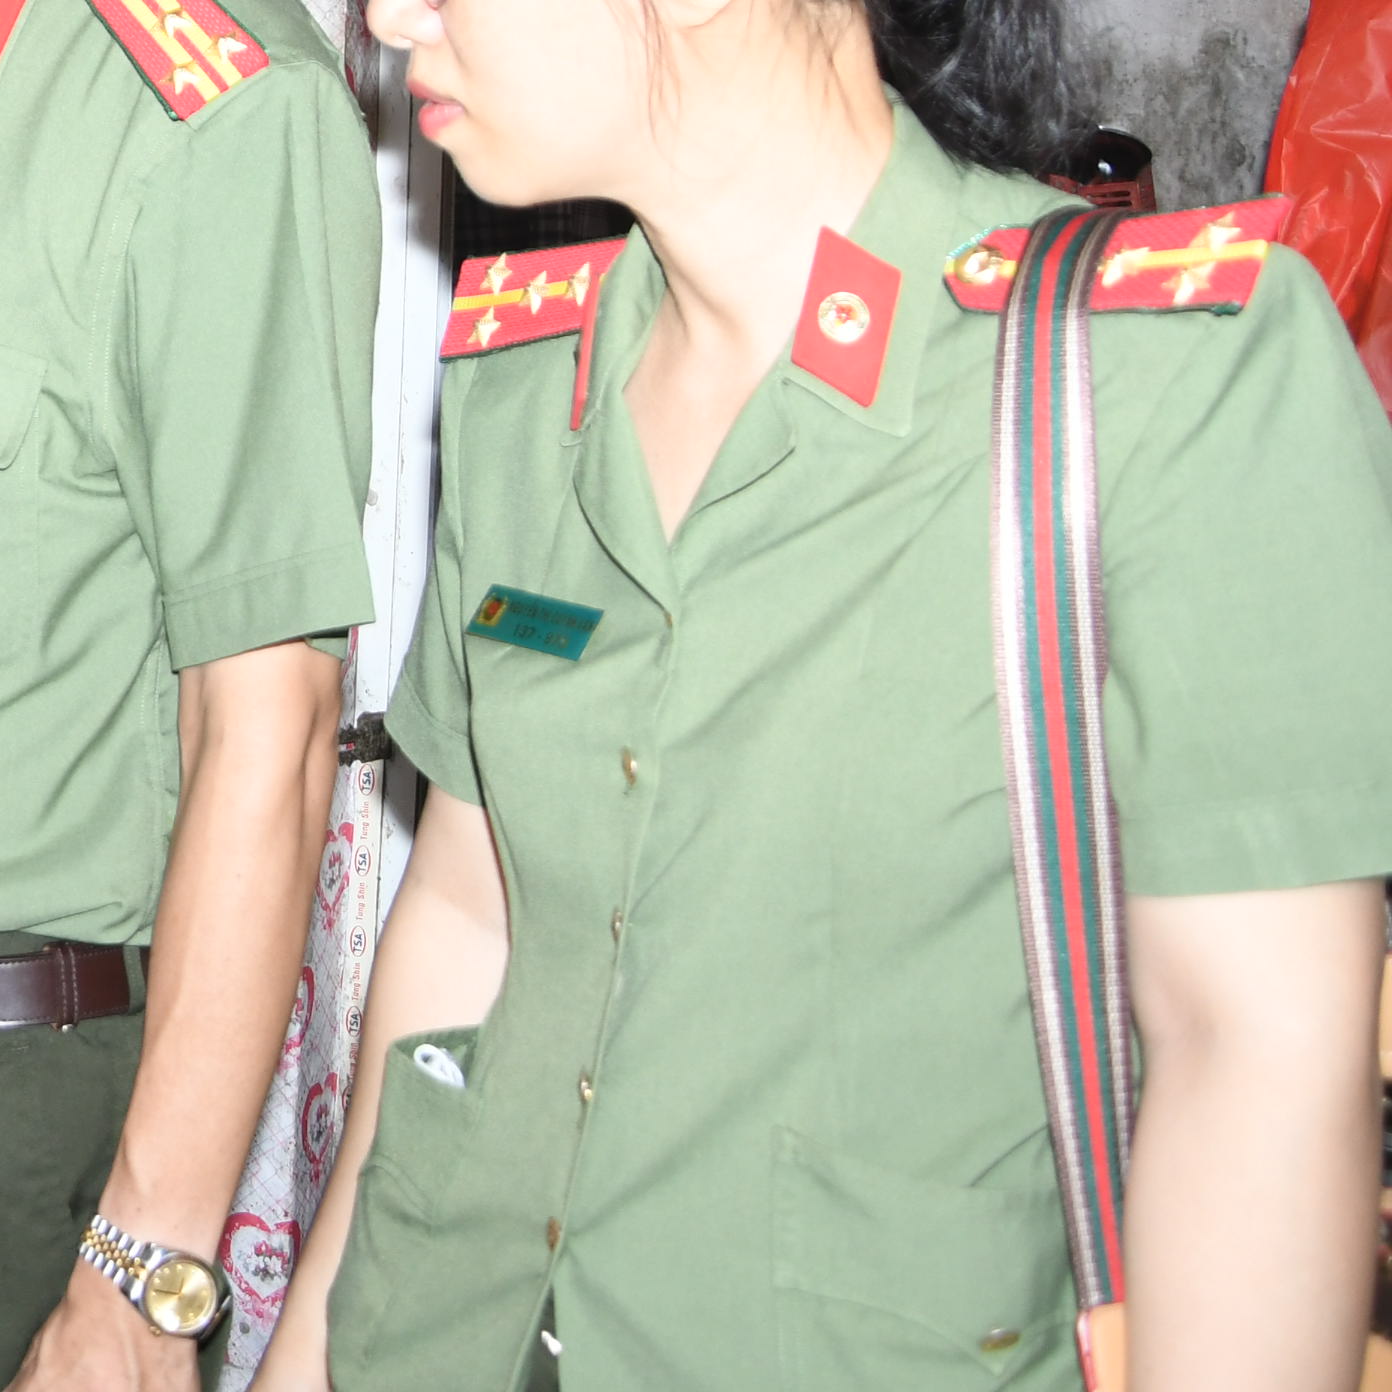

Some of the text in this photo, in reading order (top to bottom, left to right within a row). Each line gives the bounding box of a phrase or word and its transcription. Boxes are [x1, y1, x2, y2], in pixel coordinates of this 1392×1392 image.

[360, 770, 372, 792] TSA
[357, 852, 368, 876] TSA
[353, 933, 363, 953] TSA
[348, 1012, 360, 1033] TSA
